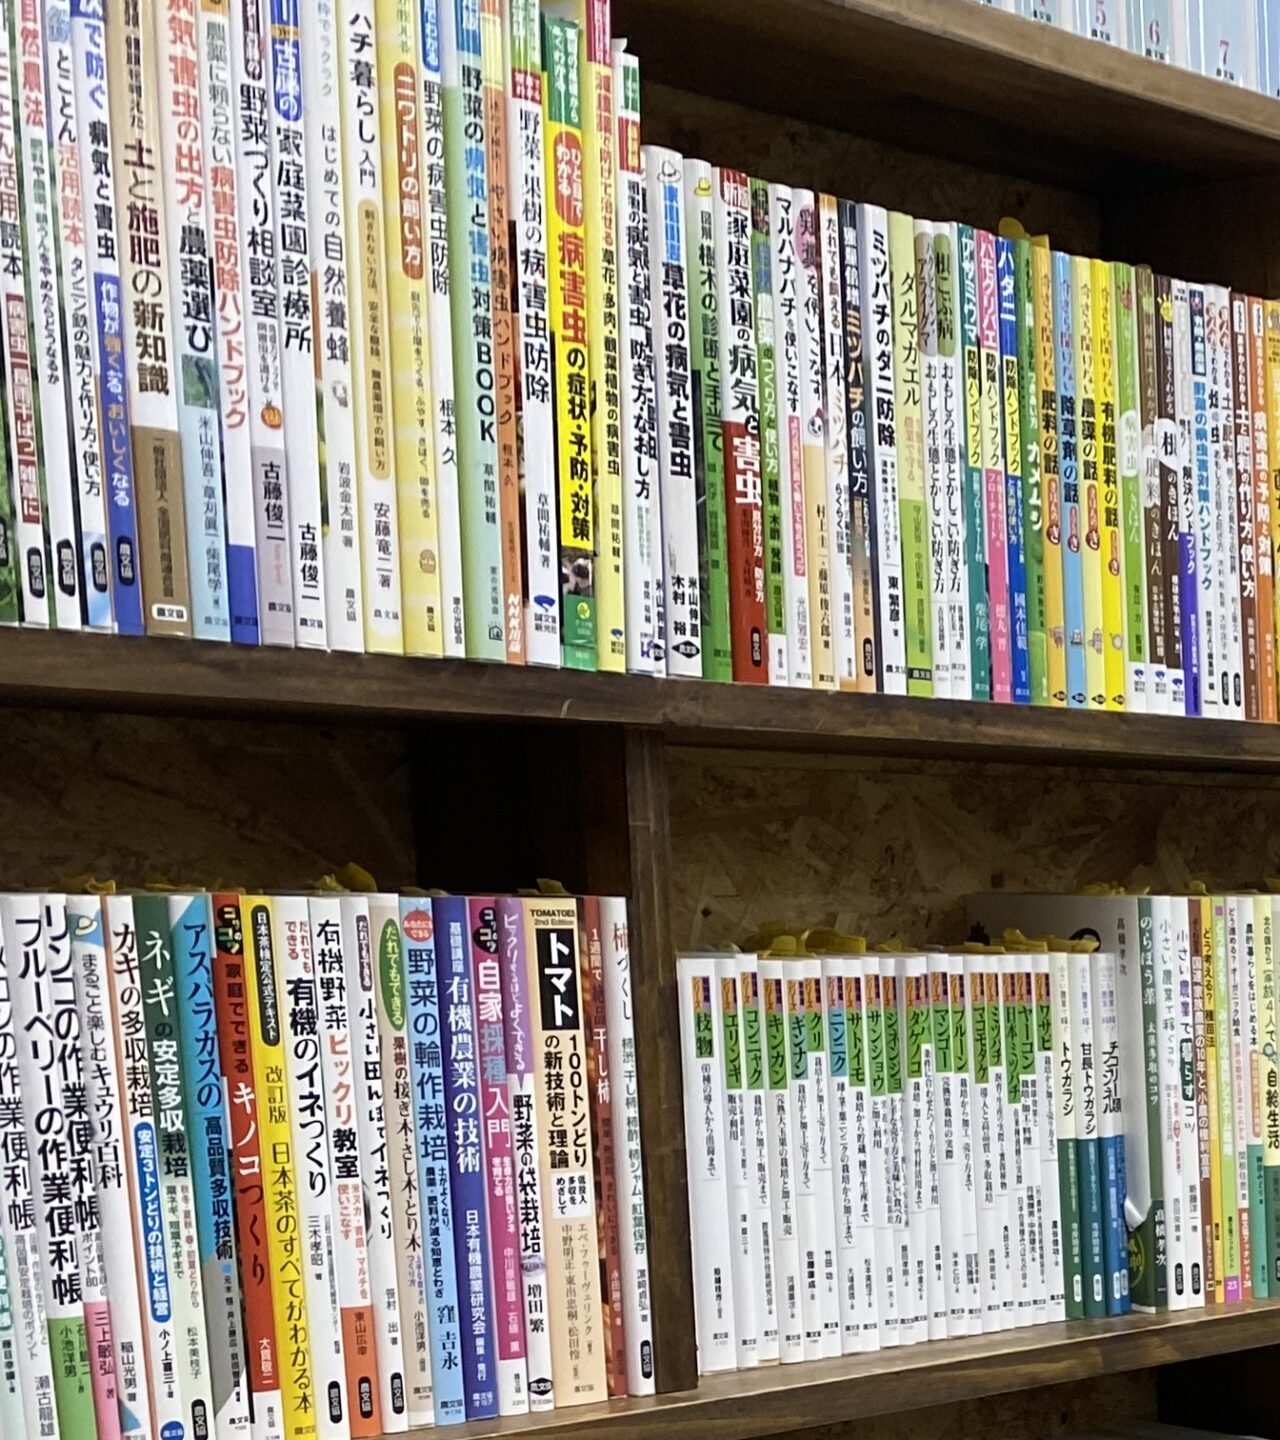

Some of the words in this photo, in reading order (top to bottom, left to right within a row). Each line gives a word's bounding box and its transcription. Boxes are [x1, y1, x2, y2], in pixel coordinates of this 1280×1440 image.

[347, 11, 377, 189] ハチ暮らし入門
[1148, 20, 1161, 45] 6
[1219, 40, 1230, 65] 7
[276, 127, 312, 353] 家庭菜園診療所
[320, 123, 350, 365] はじめての自然養蜂
[395, 66, 424, 268] ニワトリの飼い方
[424, 79, 450, 295] 野菜の病害虫防除
[121, 138, 171, 398] 土と施肥の新知識
[518, 108, 550, 404] 野菜・果樹の病害虫防除
[776, 198, 799, 412] マルハナバチを使いこなす
[998, 241, 1016, 321] ハダニ
[661, 261, 693, 479] 草花の病気と害虫
[872, 229, 896, 447] ミツバチのダニ防除
[112, 921, 154, 1118] カキの多収栽培
[142, 928, 189, 1179] ネギの安定多収栽培
[408, 947, 446, 1163] 野菜の輪作栽培
[477, 960, 510, 1149] 自家採種入門
[544, 933, 574, 1026] トマト
[696, 1014, 712, 1056] 枝物
[725, 1015, 740, 1084] エリンギ
[746, 1010, 762, 1084] コンニャク
[769, 1015, 785, 1087] キンカン
[830, 1012, 846, 1071] ニンニク
[848, 1014, 865, 1082] サトイモ
[868, 1011, 884, 1091] サンショウ
[935, 1010, 950, 1069] マンゴー
[973, 1008, 987, 1080] マコモタケ
[265, 1065, 287, 1125] 改訂版
[446, 976, 482, 1173] 有機農業の技術
[544, 1035, 570, 1168] の新技術と理論
[568, 1035, 587, 1168] 100トンどり
[270, 1143, 314, 1415] 日本茶のすべてがわかる本
